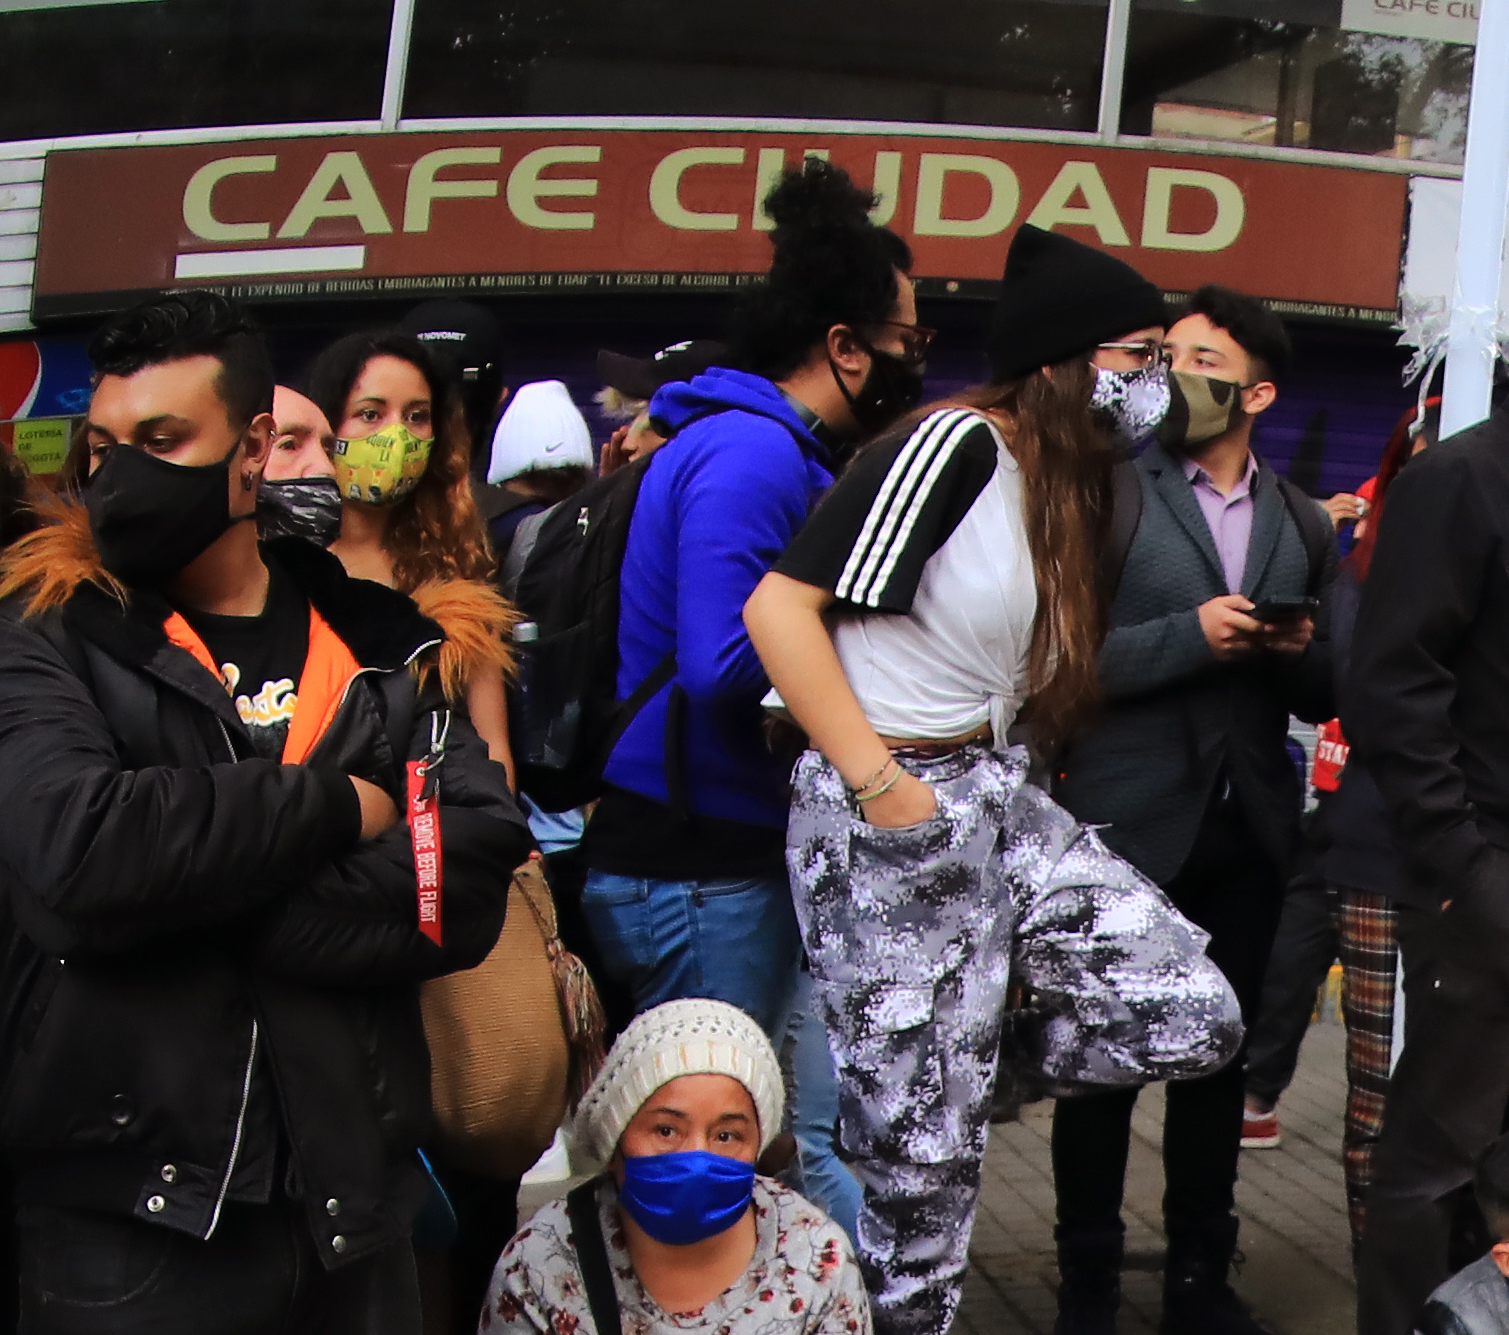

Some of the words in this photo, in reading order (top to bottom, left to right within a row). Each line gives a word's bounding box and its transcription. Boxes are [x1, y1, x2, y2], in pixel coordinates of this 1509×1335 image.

[181, 146, 602, 241] CAFE
[18, 428, 64, 441] LOTERIA
[413, 811, 434, 851] REMOVE
[416, 852, 437, 889] BEFORE
[418, 889, 436, 926] FLIGHT
